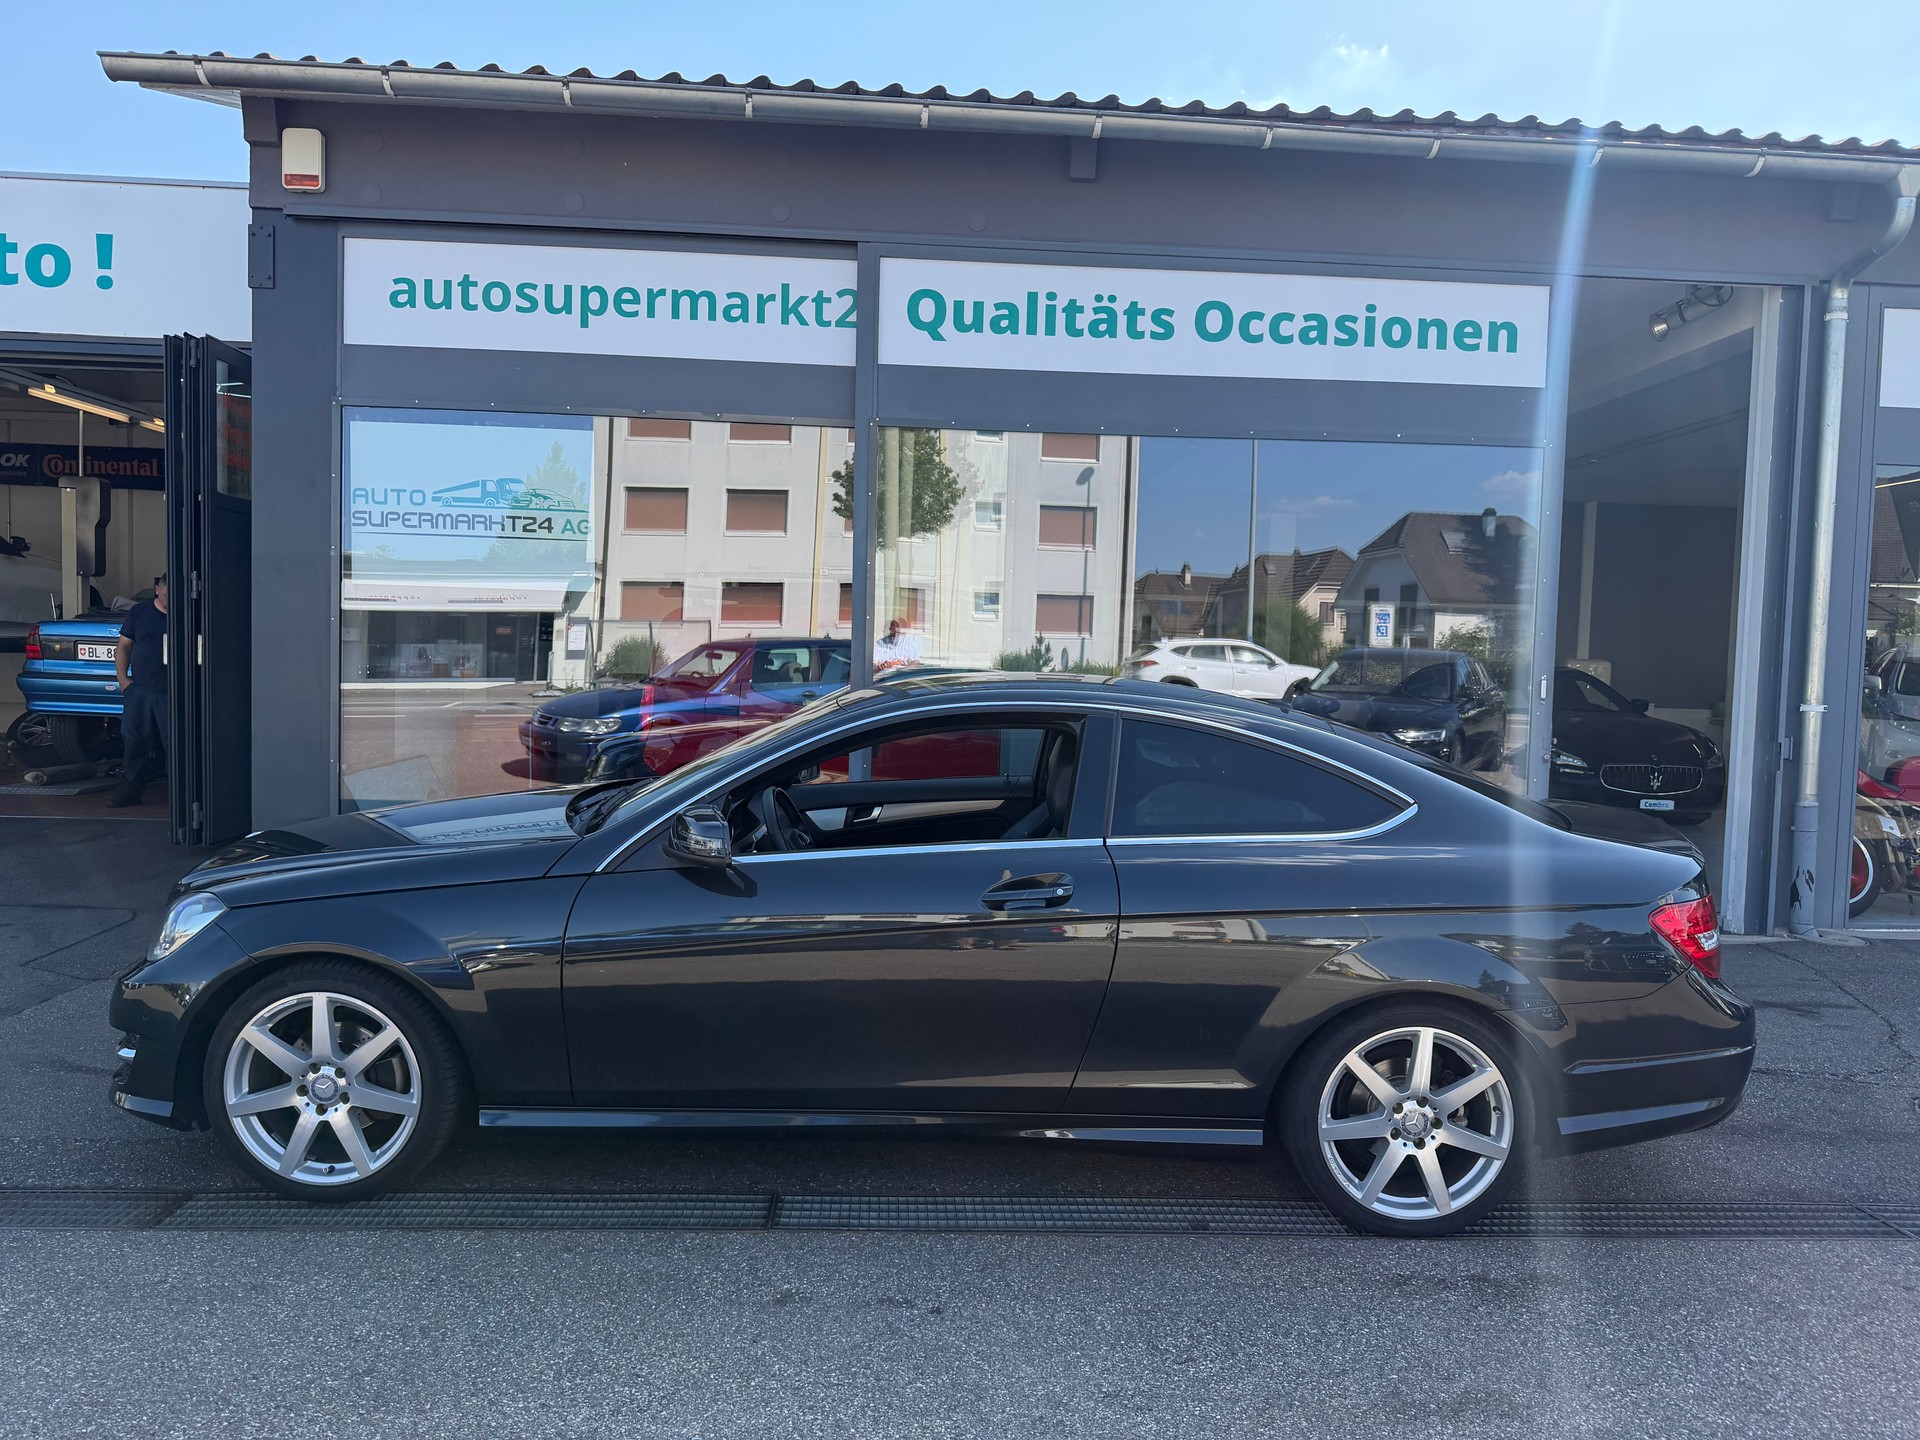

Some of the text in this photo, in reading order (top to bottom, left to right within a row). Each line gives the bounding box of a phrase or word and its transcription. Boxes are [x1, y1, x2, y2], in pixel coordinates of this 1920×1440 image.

[95, 233, 114, 290] !
[389, 274, 857, 329] autosupermarkt2
[906, 288, 1520, 353] Qualitäts Occasionen
[42, 454, 159, 478] Coninental
[352, 487, 426, 506] AUTO
[351, 510, 591, 536] SUPERMARKT24 AG
[88, 647, 101, 659] BL
[1644, 801, 1669, 809] Cembra
